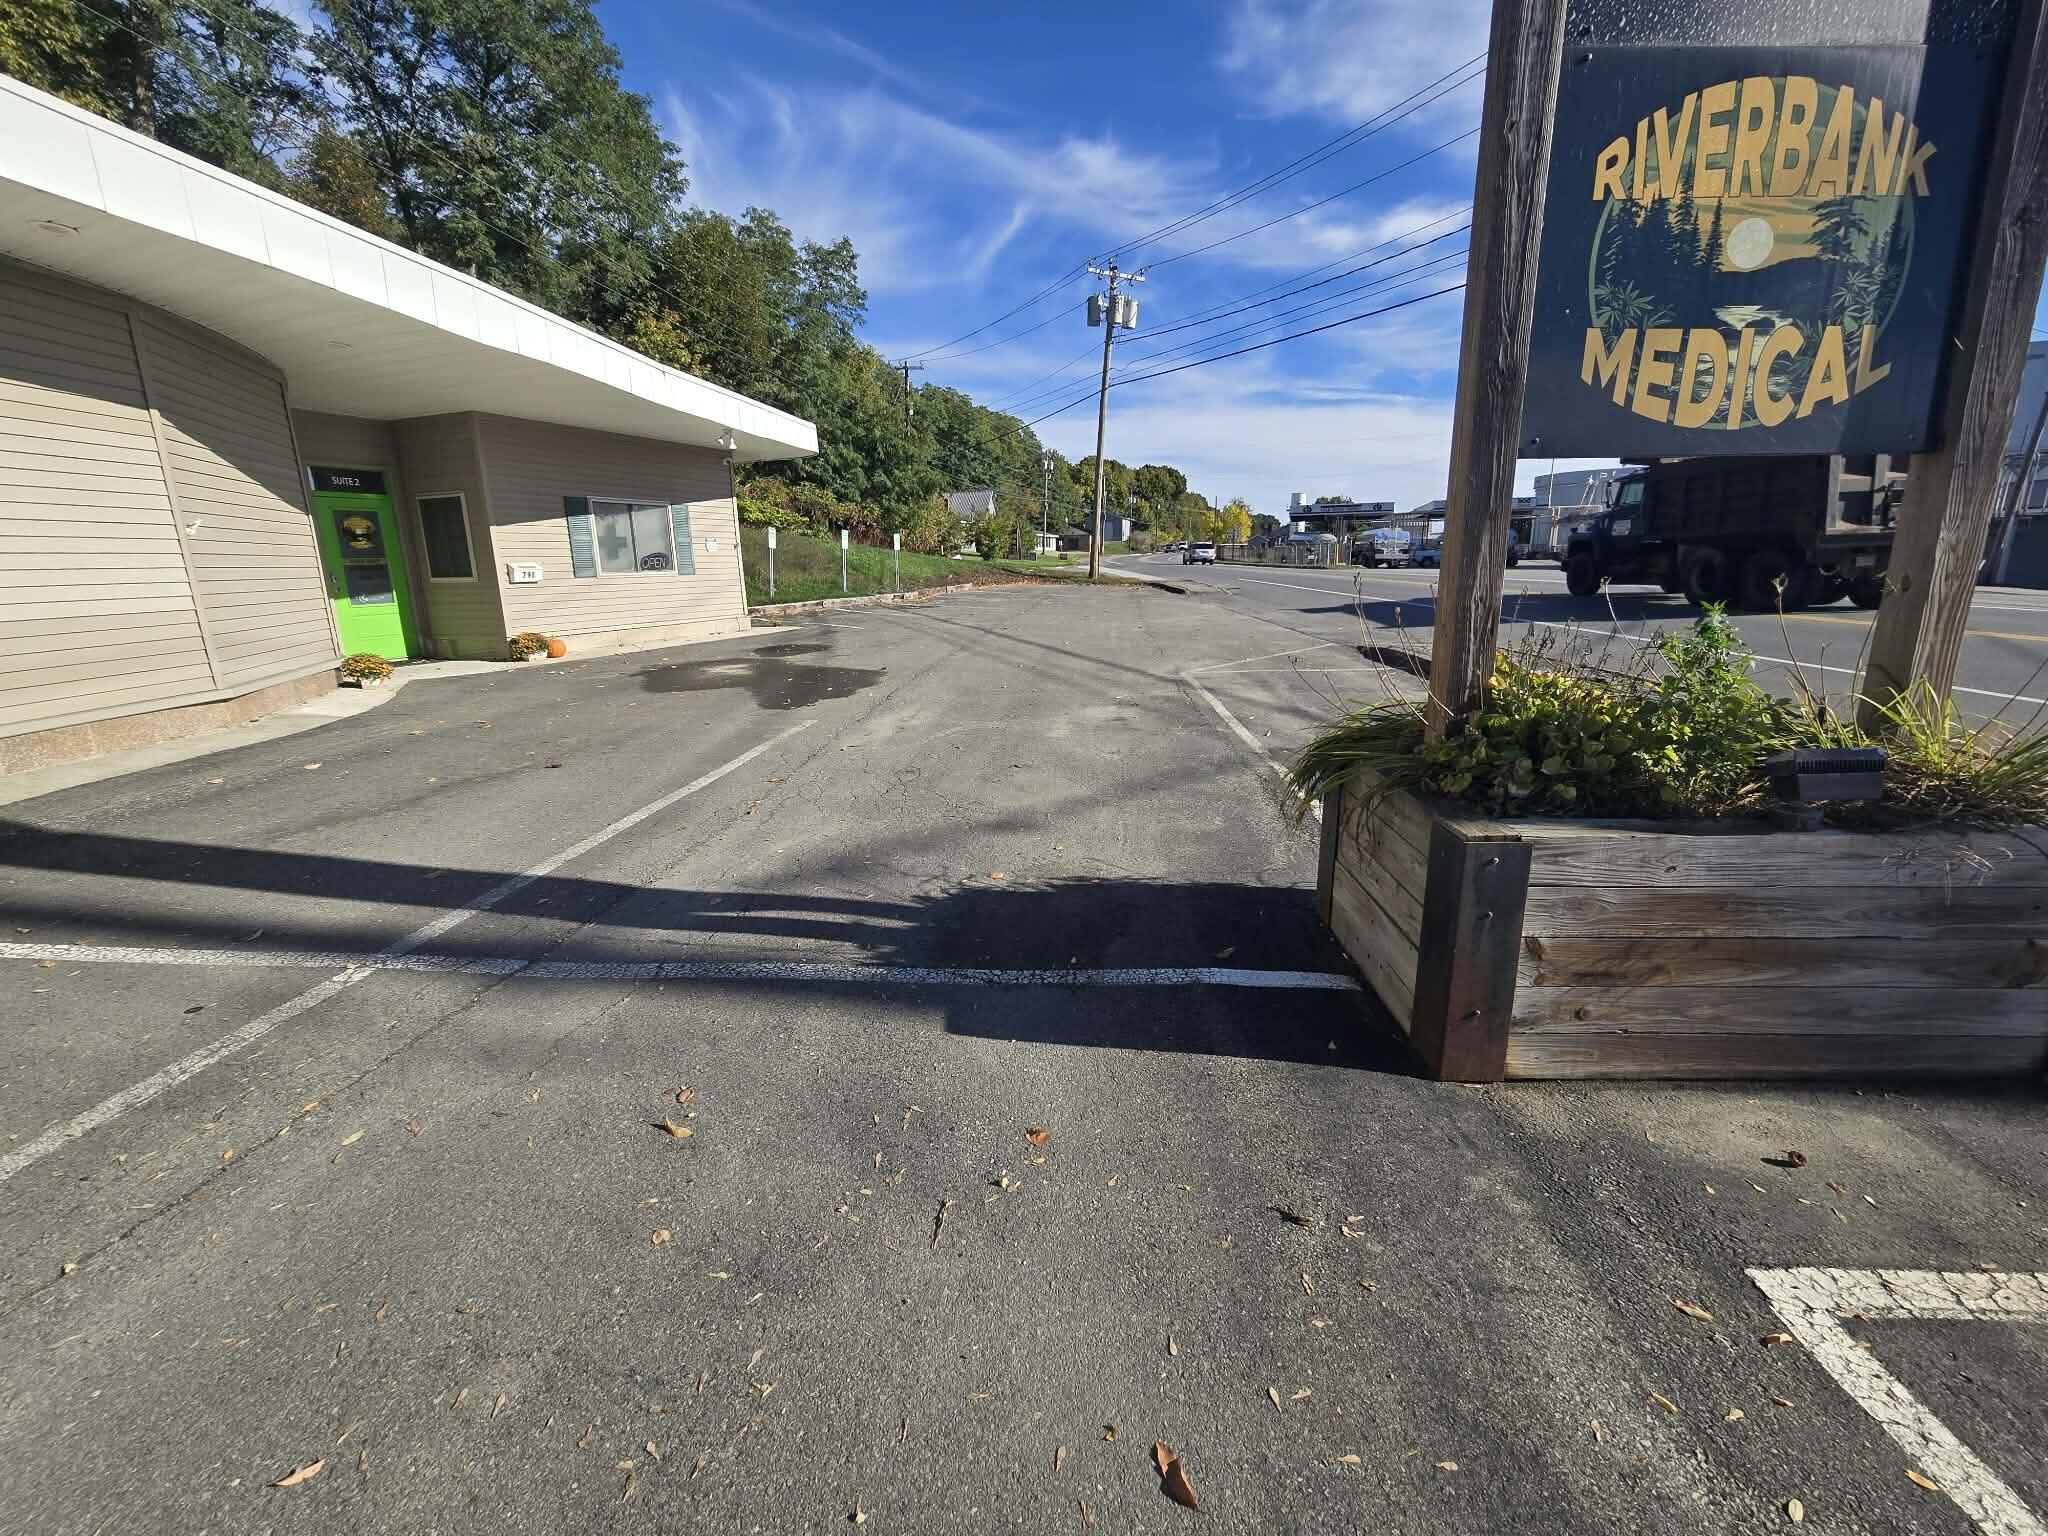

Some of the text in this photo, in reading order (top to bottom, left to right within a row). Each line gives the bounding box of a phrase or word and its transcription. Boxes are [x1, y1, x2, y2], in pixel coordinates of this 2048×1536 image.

[1593, 76, 1937, 200] RIVERBANK
[1581, 324, 1892, 430] MEDICAL
[331, 476, 360, 487] SUITE 2
[642, 557, 666, 569] OPEN
